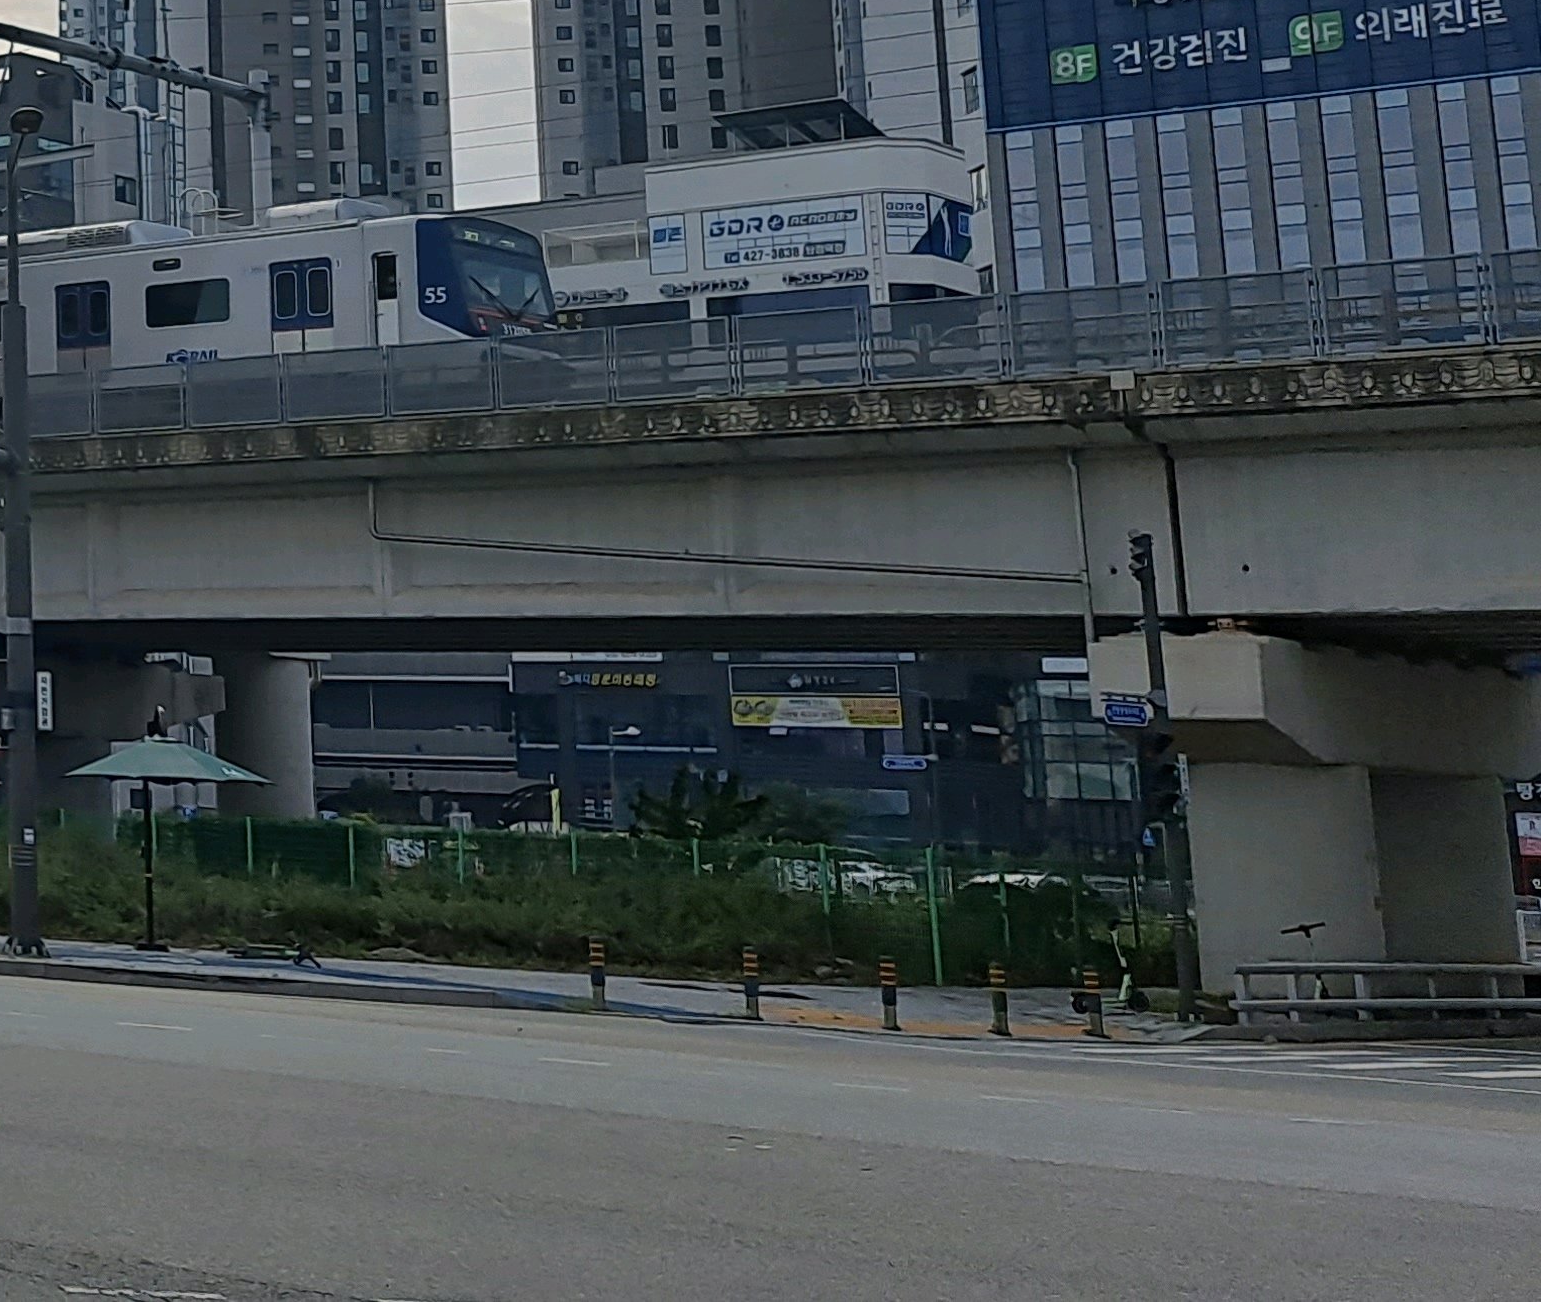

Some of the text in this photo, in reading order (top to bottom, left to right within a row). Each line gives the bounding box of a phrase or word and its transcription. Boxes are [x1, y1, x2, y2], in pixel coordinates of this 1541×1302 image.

[1055, 50, 1094, 78] 8F
[1111, 26, 1247, 75] 건강검진
[1295, 16, 1340, 51] 9F
[709, 217, 763, 237] GDR
[424, 286, 447, 304] 55
